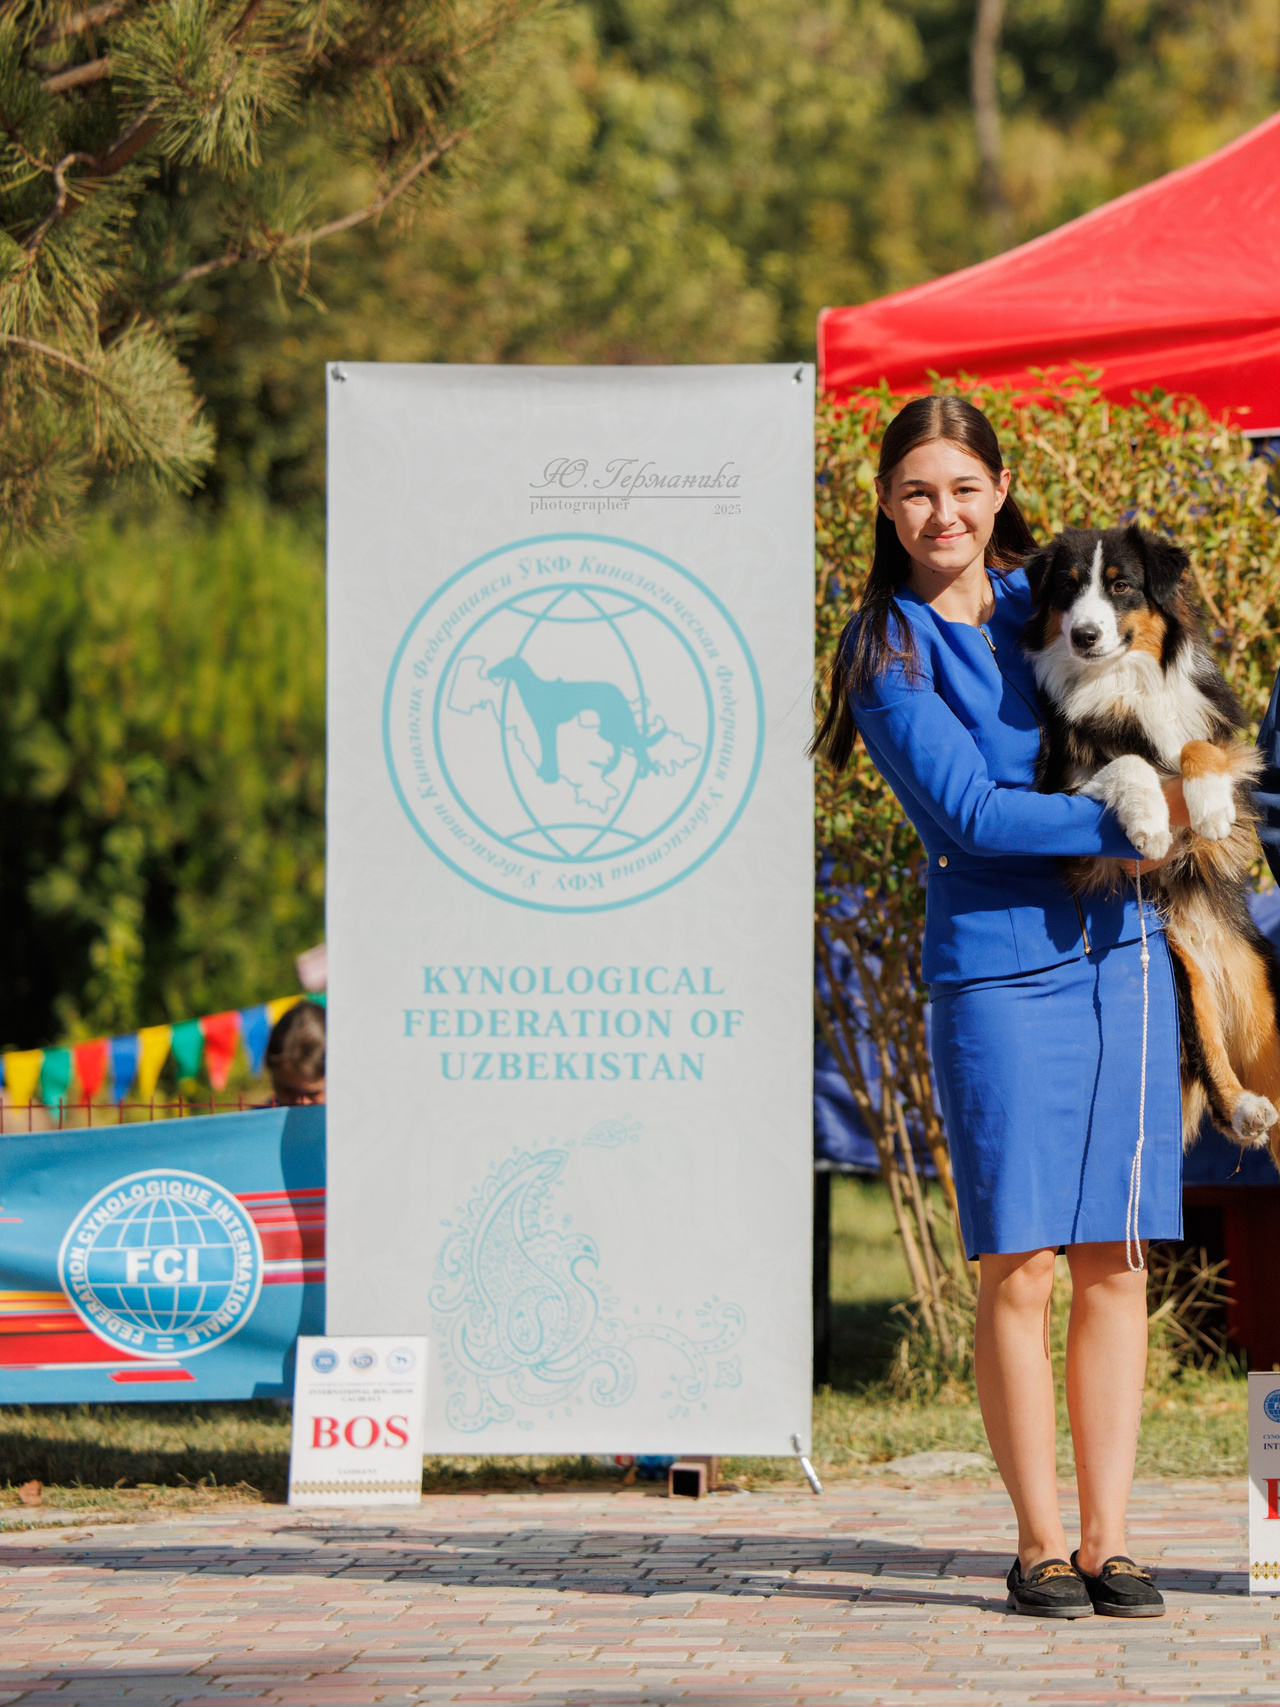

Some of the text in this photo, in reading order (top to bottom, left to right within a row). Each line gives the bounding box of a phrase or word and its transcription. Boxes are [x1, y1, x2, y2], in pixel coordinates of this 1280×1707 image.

[413, 573, 512, 679] Федерацияси
[579, 554, 720, 659] Кинологическая
[408, 684, 438, 799] Кинологик
[714, 665, 738, 781] Федерация
[611, 786, 724, 880] Узбекистана
[552, 872, 604, 892] КФУ
[421, 965, 725, 995] KYNOLOGICAL
[402, 1008, 744, 1038] FEDERATION OF
[439, 1051, 706, 1081] UZBEKISTAN
[69, 1180, 254, 1345] FEDERATION CYNOLOGIQUE INTERNATIONALE
[126, 1248, 199, 1283] FCI
[309, 1414, 410, 1450] BOS
